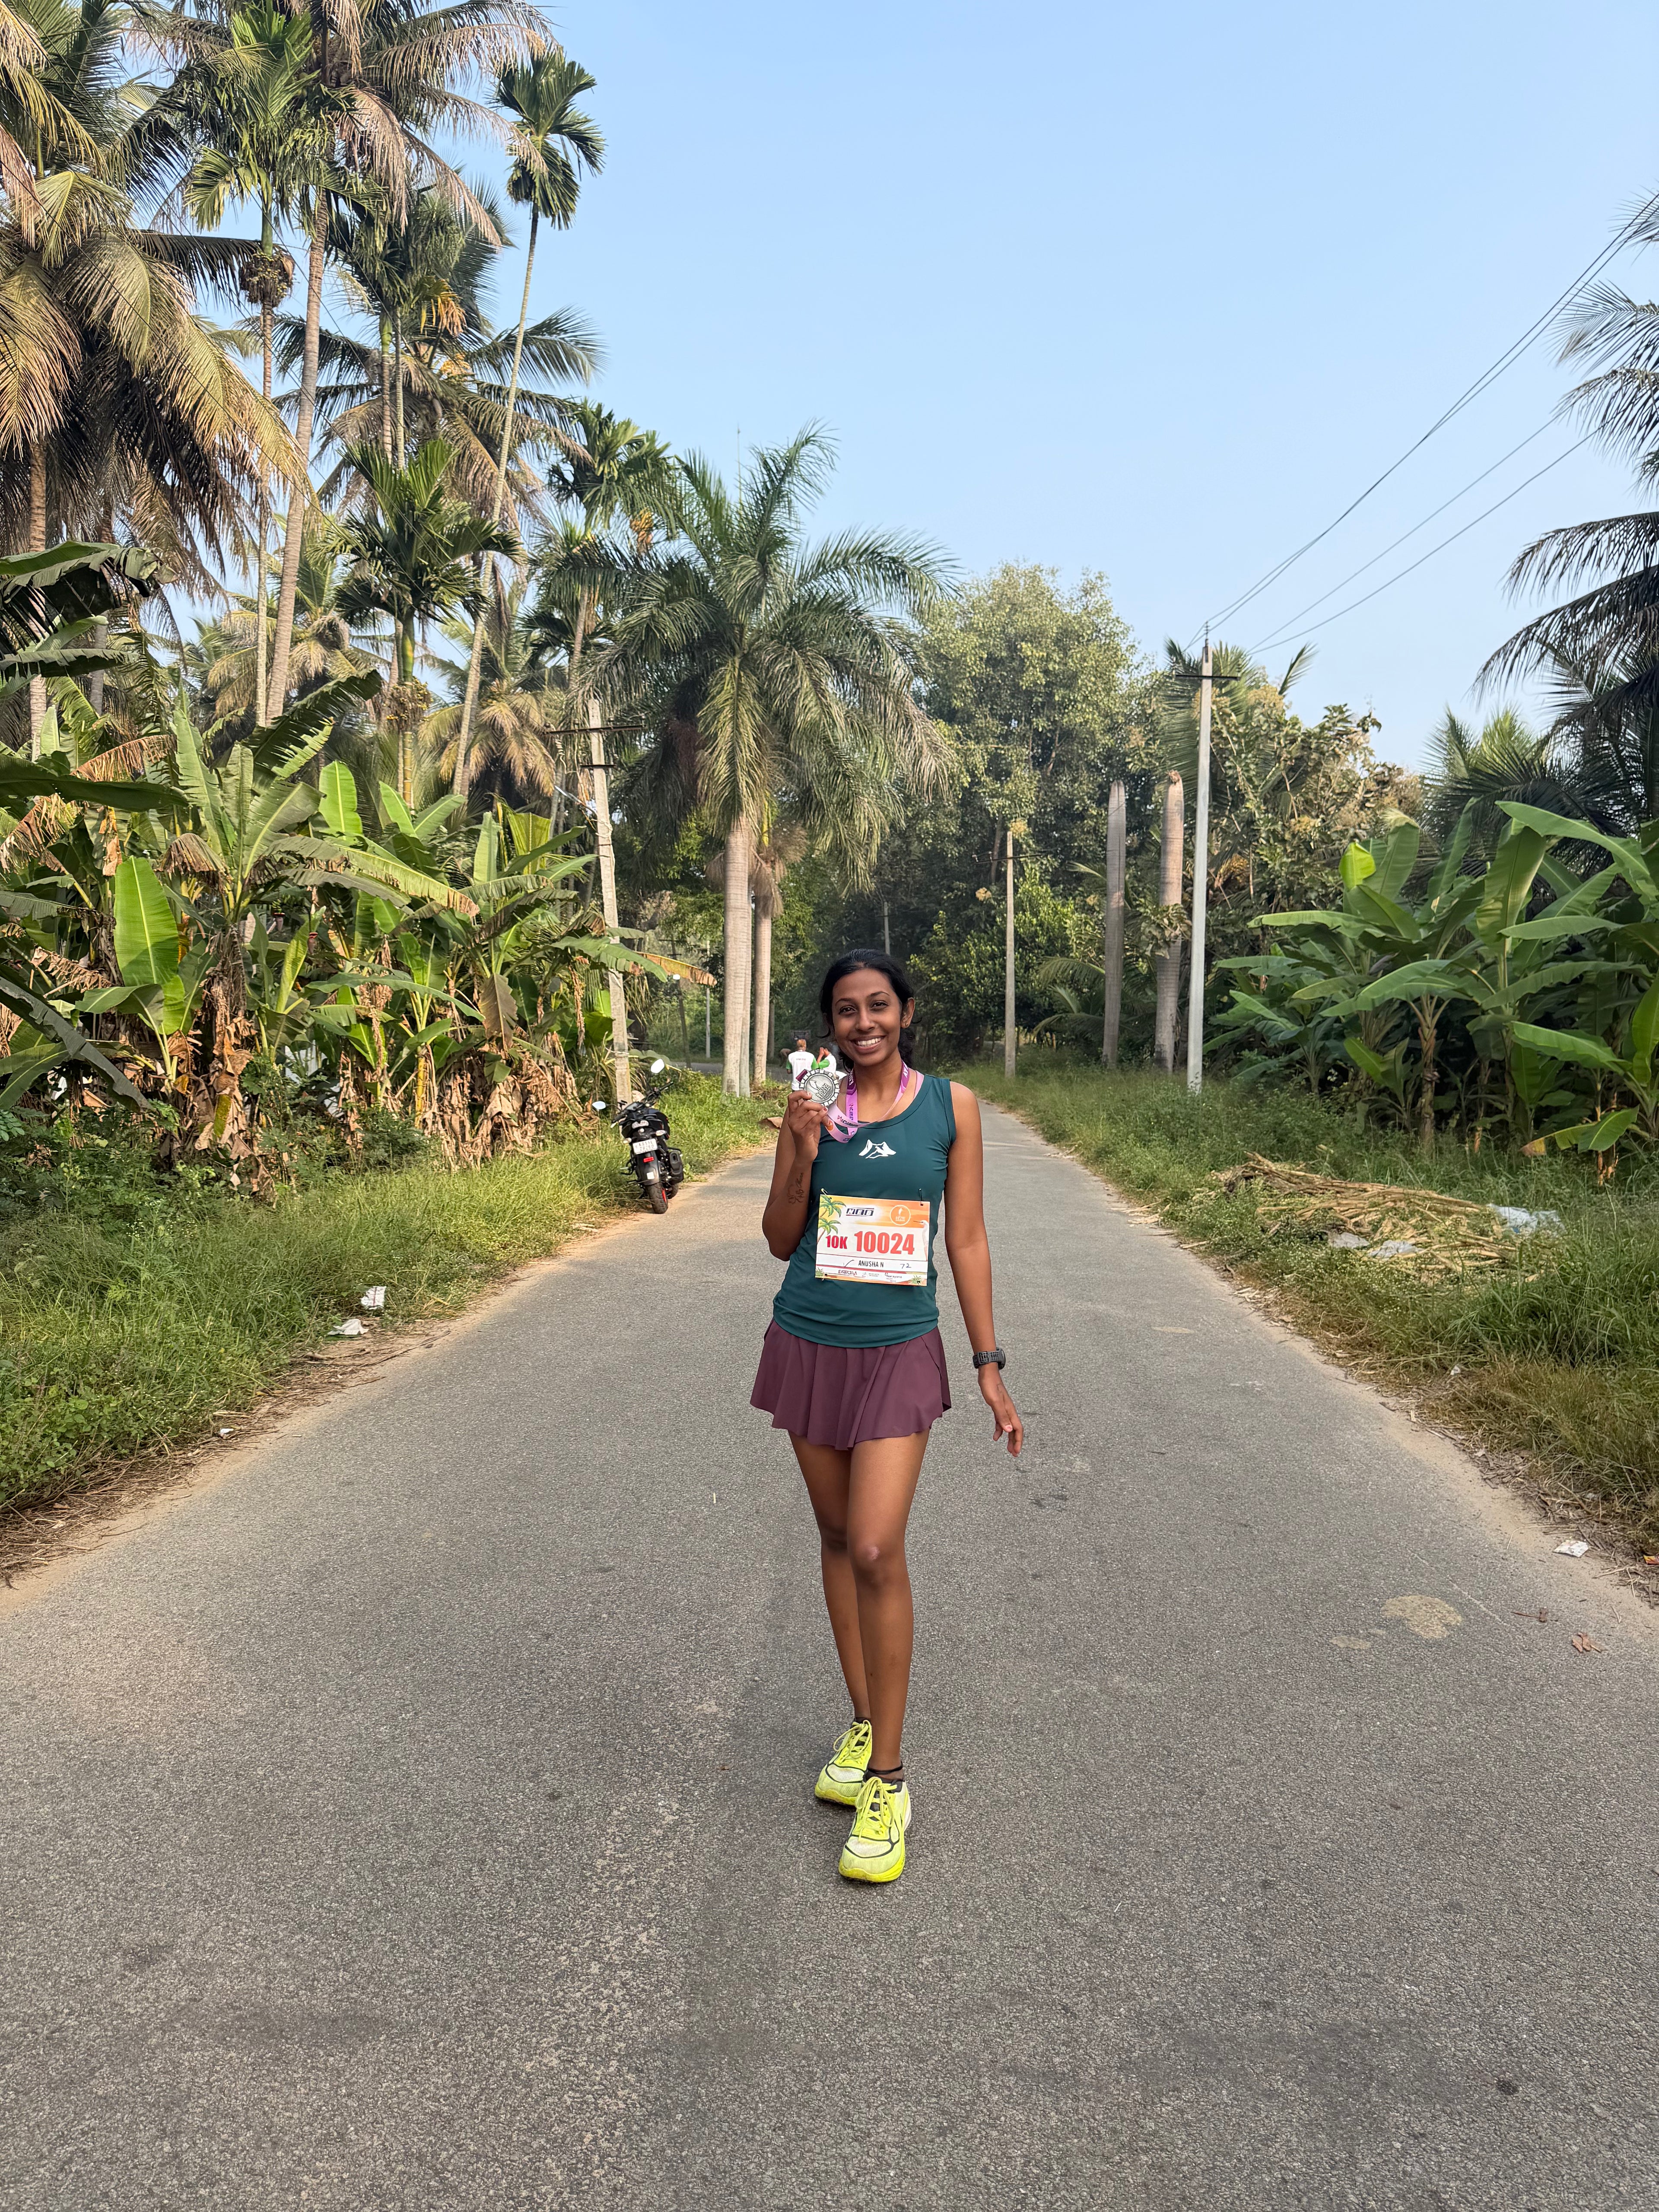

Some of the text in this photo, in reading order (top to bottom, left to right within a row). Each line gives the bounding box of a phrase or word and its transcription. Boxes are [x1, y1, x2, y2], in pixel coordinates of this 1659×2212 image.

[846, 1208, 874, 1216] NEB
[825, 1231, 915, 1255] 10K 10024
